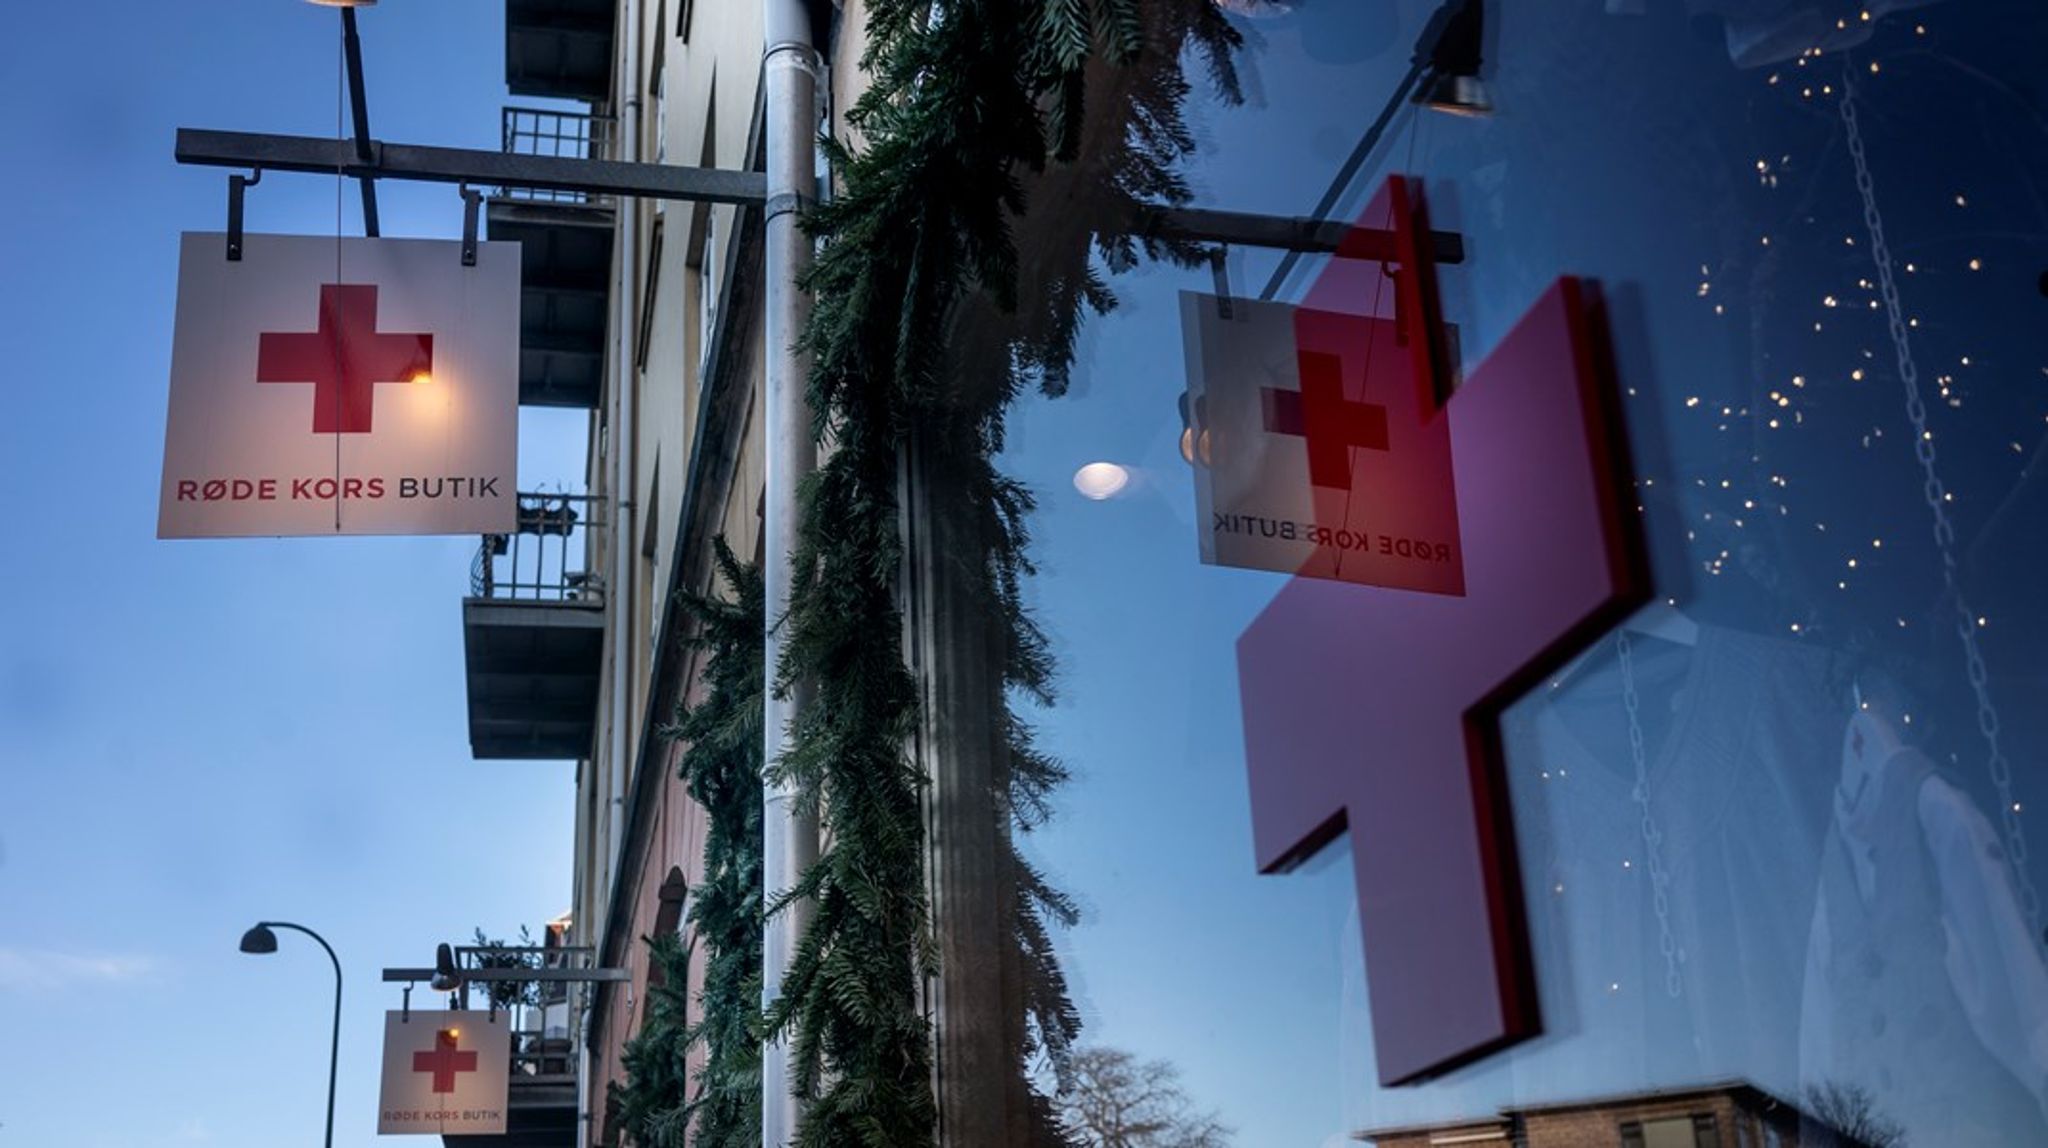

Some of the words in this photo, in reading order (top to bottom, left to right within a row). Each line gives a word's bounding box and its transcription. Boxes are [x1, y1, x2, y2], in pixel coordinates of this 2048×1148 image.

[177, 479, 277, 501] RØDE
[292, 477, 385, 499] KORS
[399, 476, 499, 499] BUTIK
[384, 1110, 420, 1121] RØDE
[424, 1110, 459, 1121] KORS
[462, 1109, 501, 1121] BUTIK
